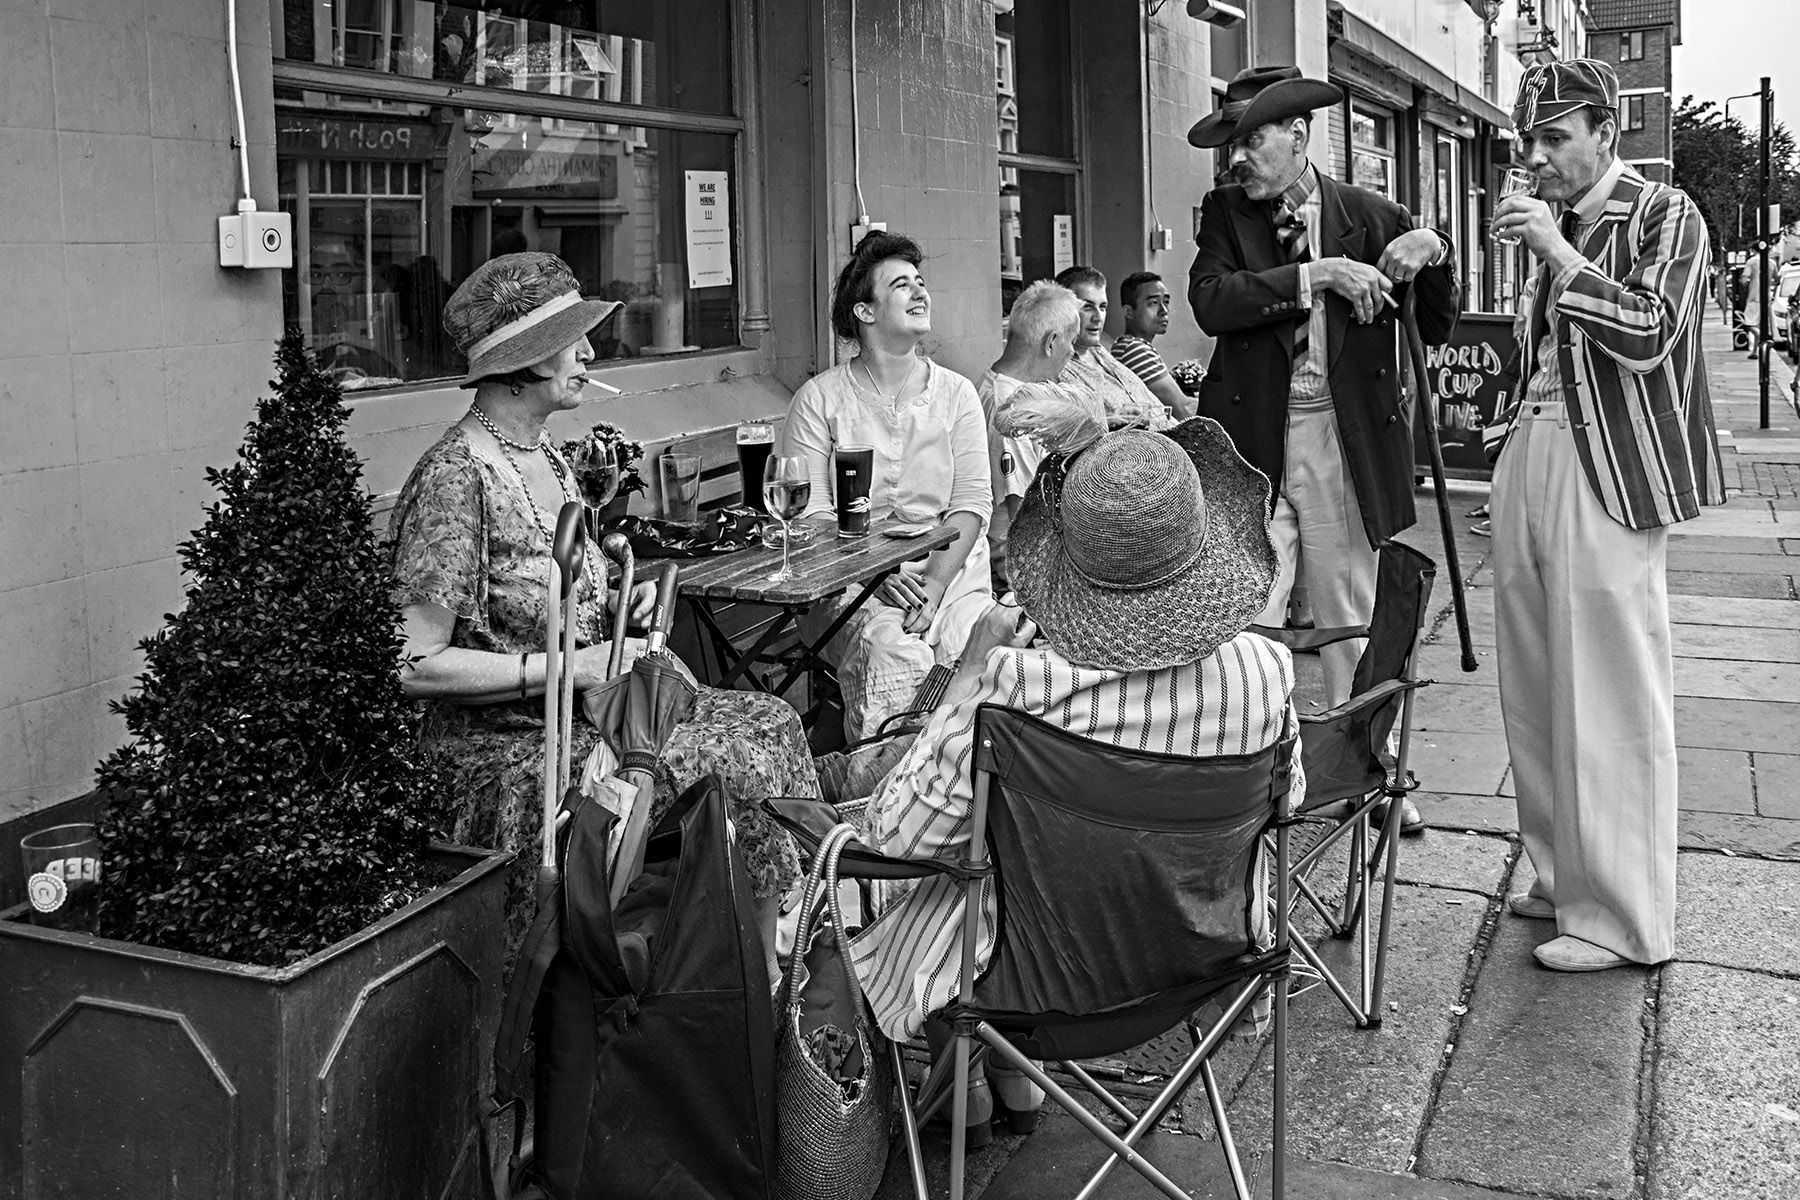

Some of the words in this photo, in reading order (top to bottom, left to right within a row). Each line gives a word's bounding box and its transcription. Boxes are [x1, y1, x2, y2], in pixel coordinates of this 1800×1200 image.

[698, 183, 707, 192] WE
[707, 183, 716, 192] ARE
[700, 196, 716, 205] HIRING
[1426, 342, 1502, 376] WORLD
[1438, 367, 1484, 399] CUP
[1432, 392, 1486, 431] LIVE
[626, 756, 655, 767] SUSINO
